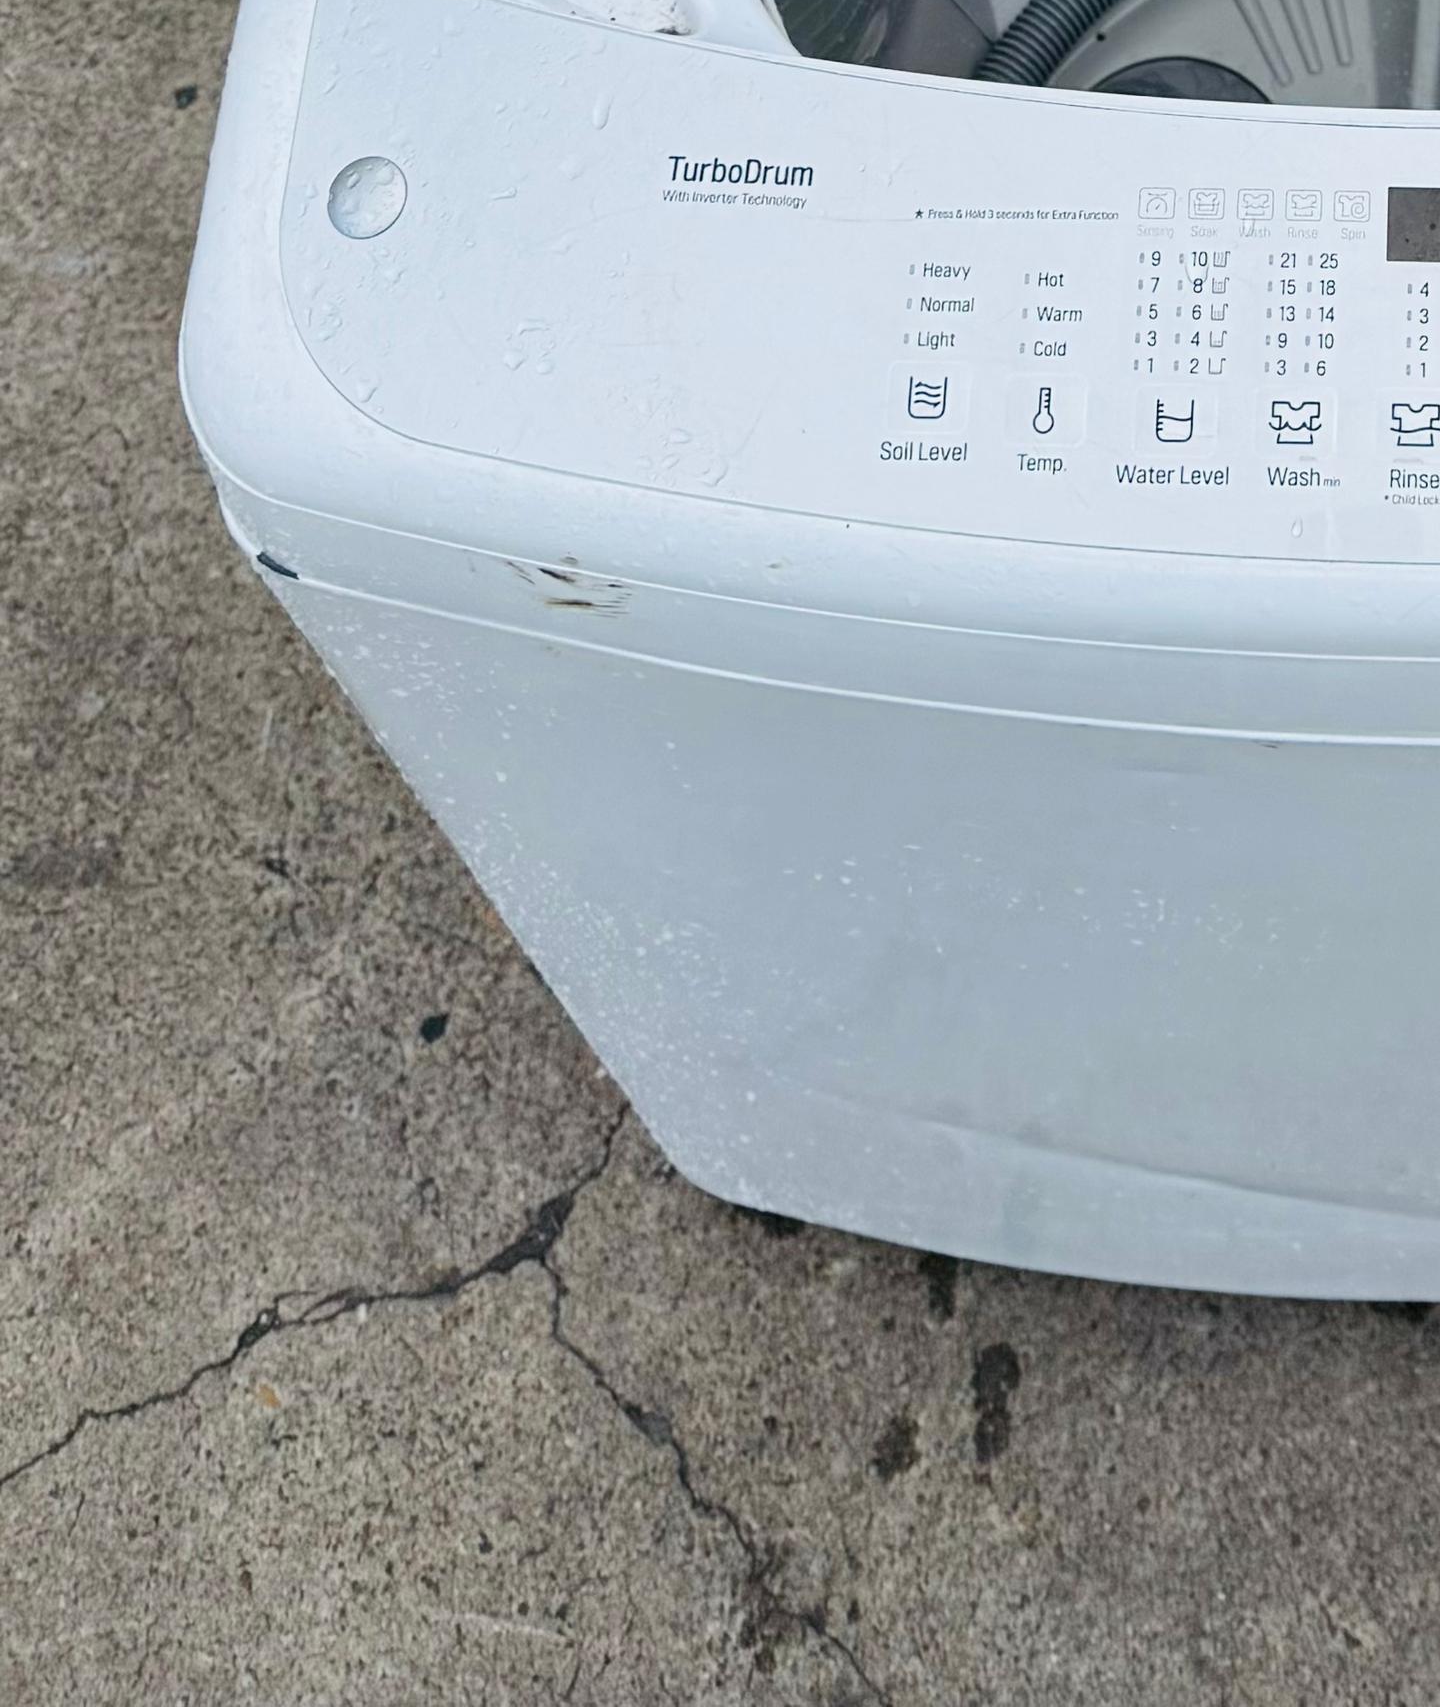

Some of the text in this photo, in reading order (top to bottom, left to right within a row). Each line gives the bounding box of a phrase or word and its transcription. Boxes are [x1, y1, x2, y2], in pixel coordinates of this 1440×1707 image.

[668, 155, 814, 187] TurboDrum
[662, 189, 807, 210] With Inverter Technology
[1190, 226, 1218, 238] Soak
[1287, 226, 1319, 239] Rinse
[1340, 227, 1367, 240] Spin
[1151, 250, 1208, 267] 9 10
[1280, 252, 1339, 270] 21 25
[922, 262, 971, 281] Heavy
[1037, 272, 1065, 287] Hot
[1150, 277, 1203, 294] 7 8
[1279, 279, 1336, 296] 15 18
[1419, 282, 1429, 298] 4
[919, 296, 975, 313] Normal
[1148, 303, 1201, 320] 5 6
[1036, 306, 1083, 322] Warm
[1279, 305, 1335, 323] 13 14
[1419, 308, 1429, 324] 3
[917, 331, 956, 351] Light
[1147, 330, 1200, 347] 3 4
[1277, 332, 1335, 349] 9 10
[1418, 335, 1429, 351] 2
[1033, 340, 1067, 357] Cold
[1147, 357, 1199, 374] 1 2
[1276, 359, 1326, 376] 3 6
[1420, 362, 1427, 378] 1
[879, 441, 968, 462] Soil Level
[1017, 453, 1067, 475] Temp.
[1115, 464, 1230, 485] Water Level
[1267, 466, 1341, 487] Wash min
[1390, 468, 1440, 489] Rinse
